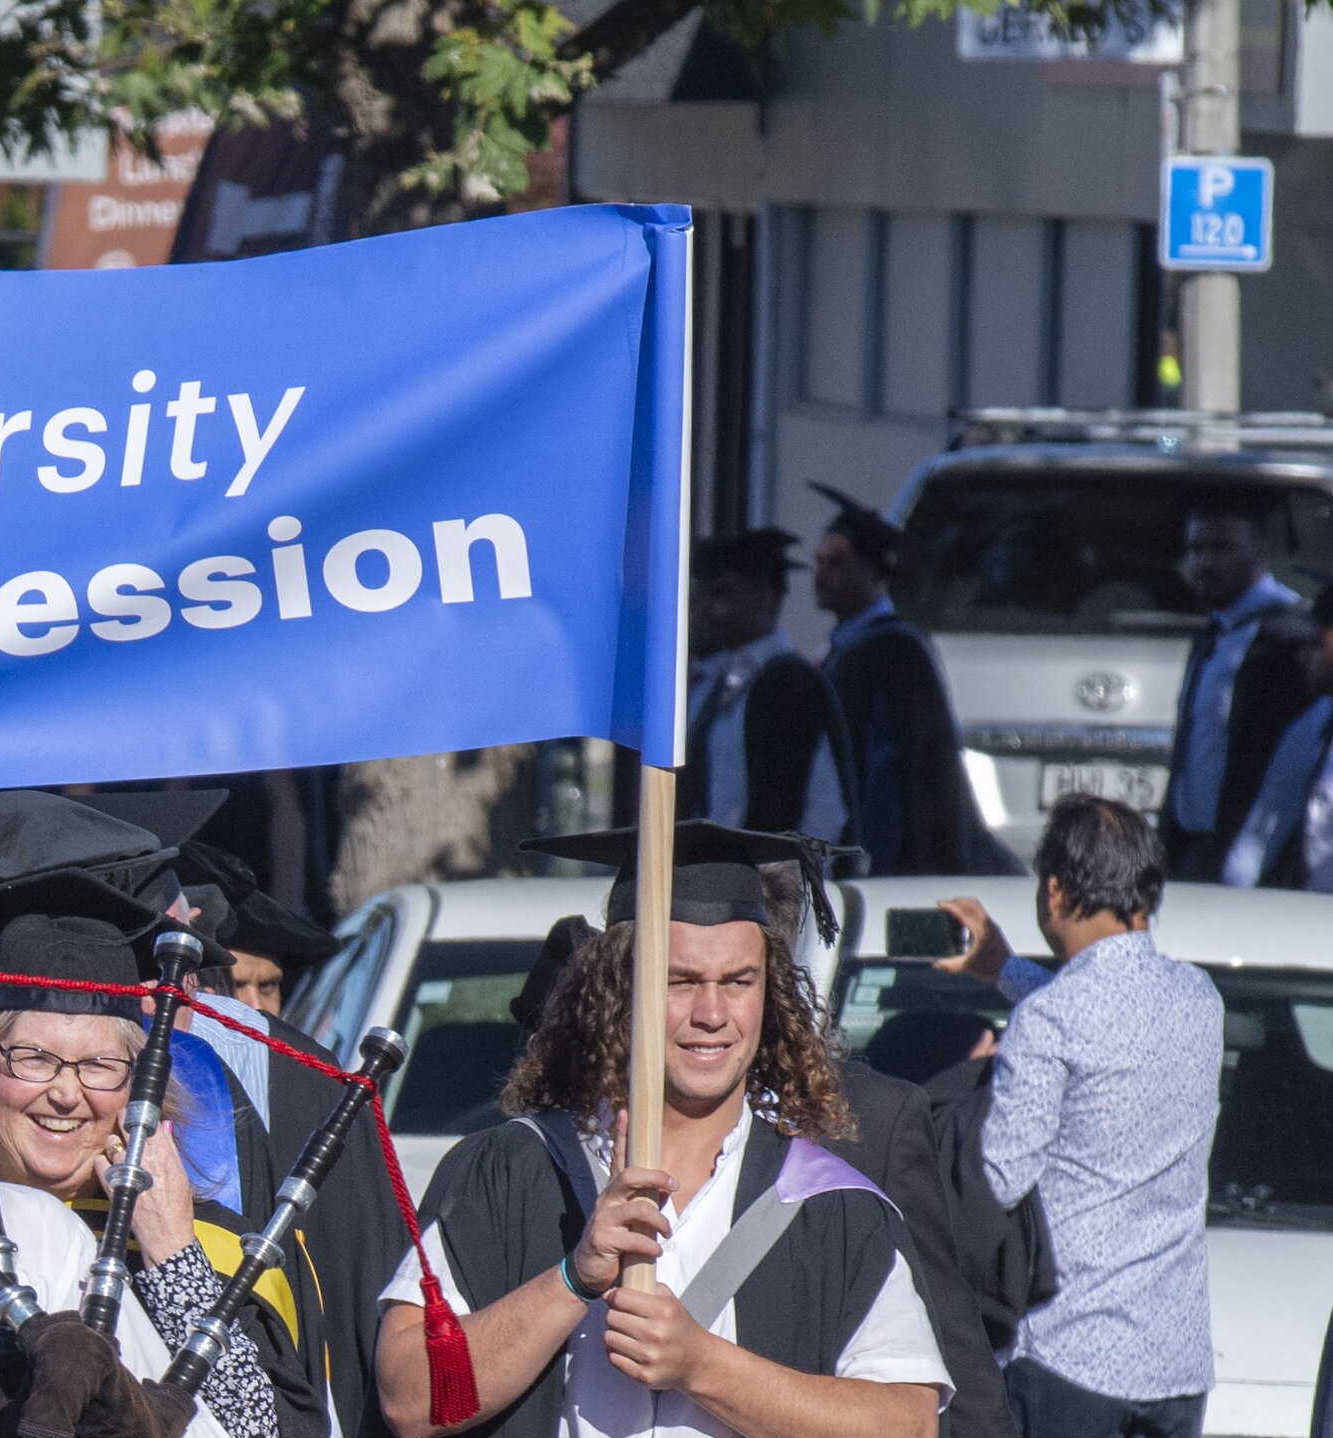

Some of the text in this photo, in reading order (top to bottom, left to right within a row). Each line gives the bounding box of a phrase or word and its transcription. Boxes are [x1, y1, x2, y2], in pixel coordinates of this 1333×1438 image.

[118, 147, 203, 186] Lunc
[1200, 166, 1234, 208] P
[1190, 213, 1245, 246] 120
